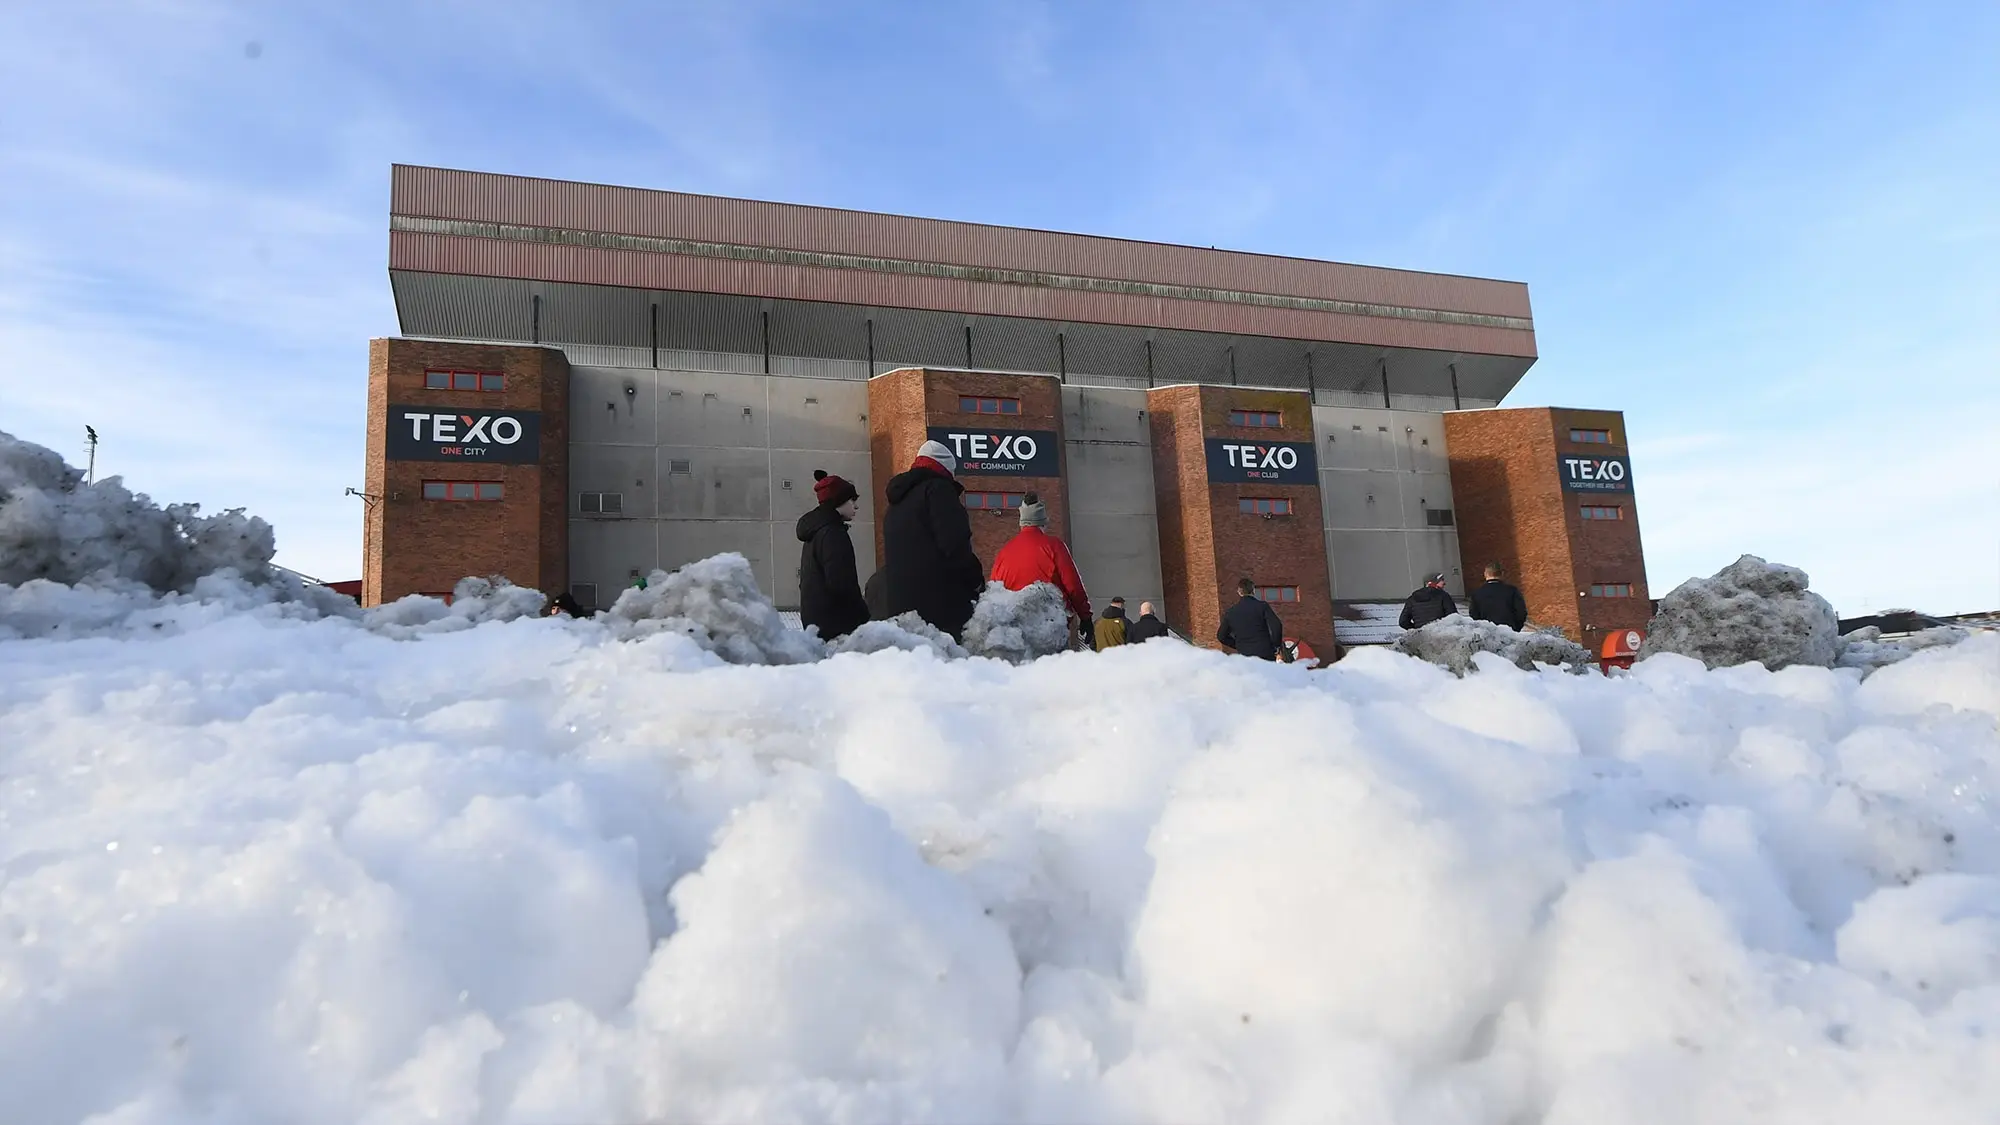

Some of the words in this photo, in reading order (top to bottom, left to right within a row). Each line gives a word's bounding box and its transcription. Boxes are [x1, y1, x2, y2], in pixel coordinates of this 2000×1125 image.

[404, 412, 523, 445] TEXO
[441, 446, 462, 455] ONE
[464, 447, 487, 456] CITY
[948, 433, 1037, 460] TEXO
[1222, 444, 1298, 470] TEXO
[963, 462, 980, 470] ONE
[981, 462, 1026, 471] COMMUNITY
[1261, 471, 1279, 479] CLUB
[1564, 459, 1625, 481] TEXO
